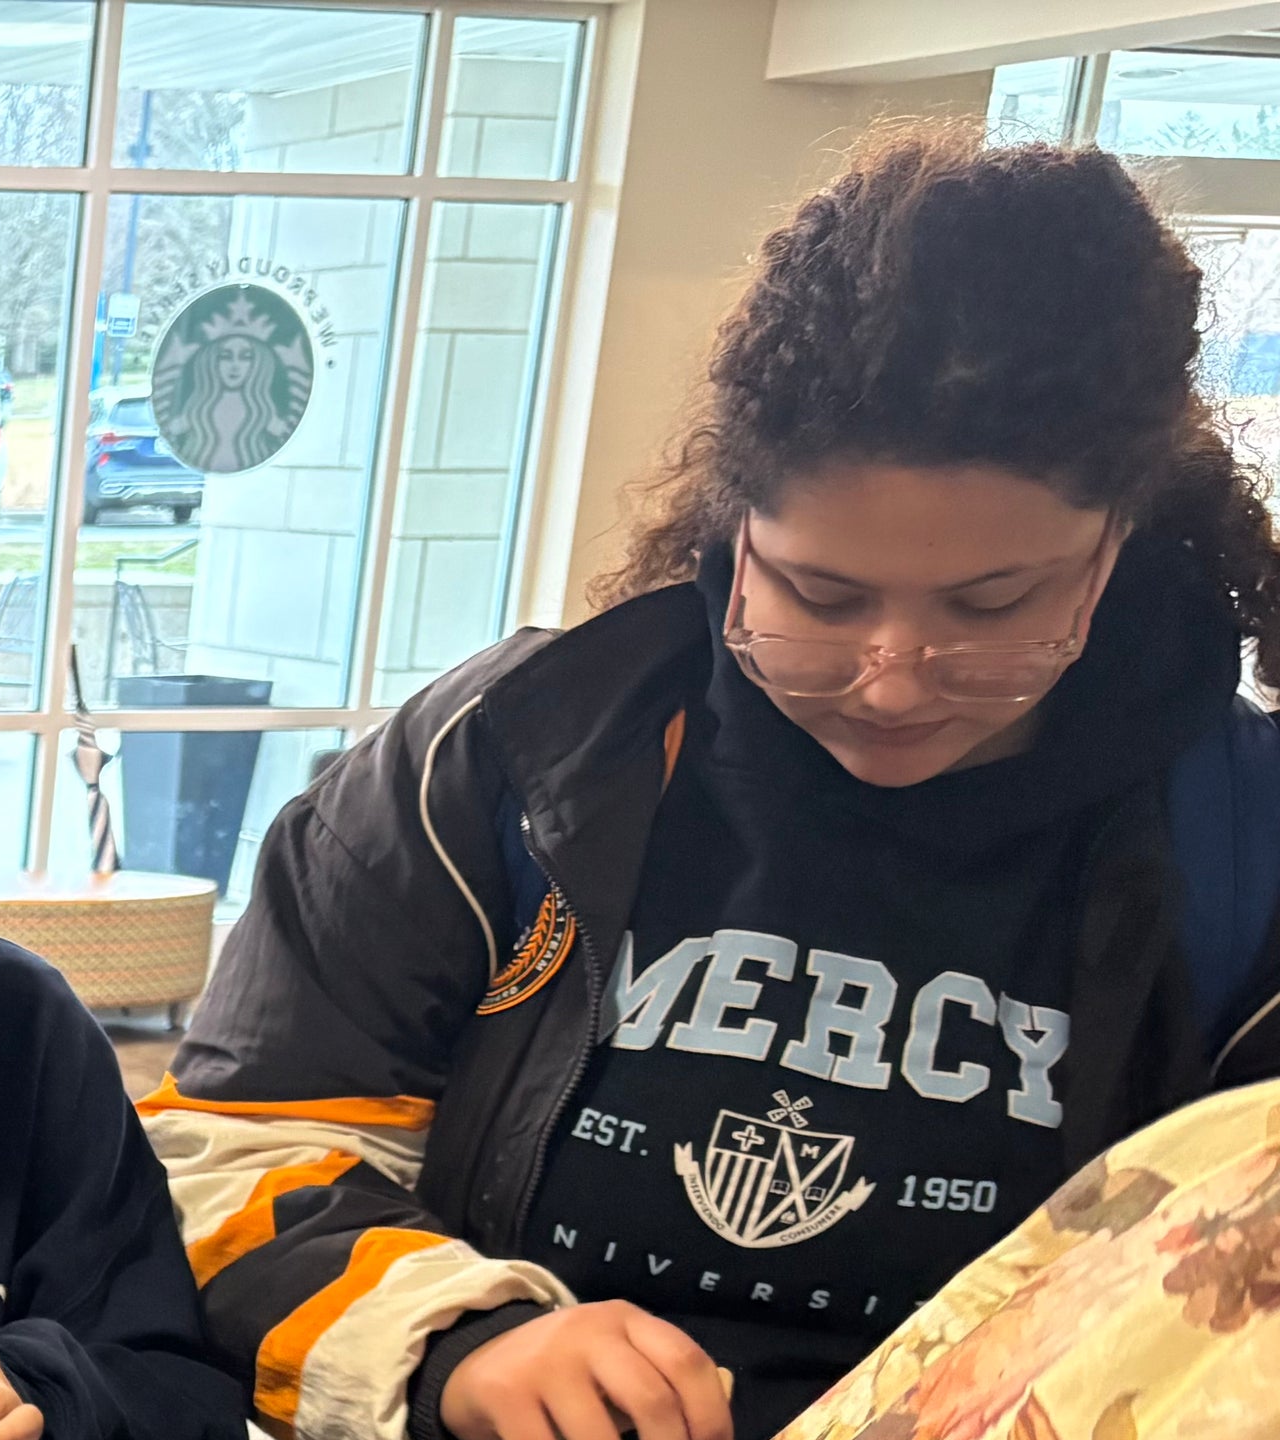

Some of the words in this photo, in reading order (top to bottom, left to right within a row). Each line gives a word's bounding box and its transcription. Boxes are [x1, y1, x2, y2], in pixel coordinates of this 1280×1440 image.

[597, 928, 1071, 1128] MERCY
[571, 1106, 649, 1157] EST.
[799, 1143, 821, 1160] M
[897, 1175, 997, 1214] 1950
[553, 1223, 928, 1316] NIVERSI
